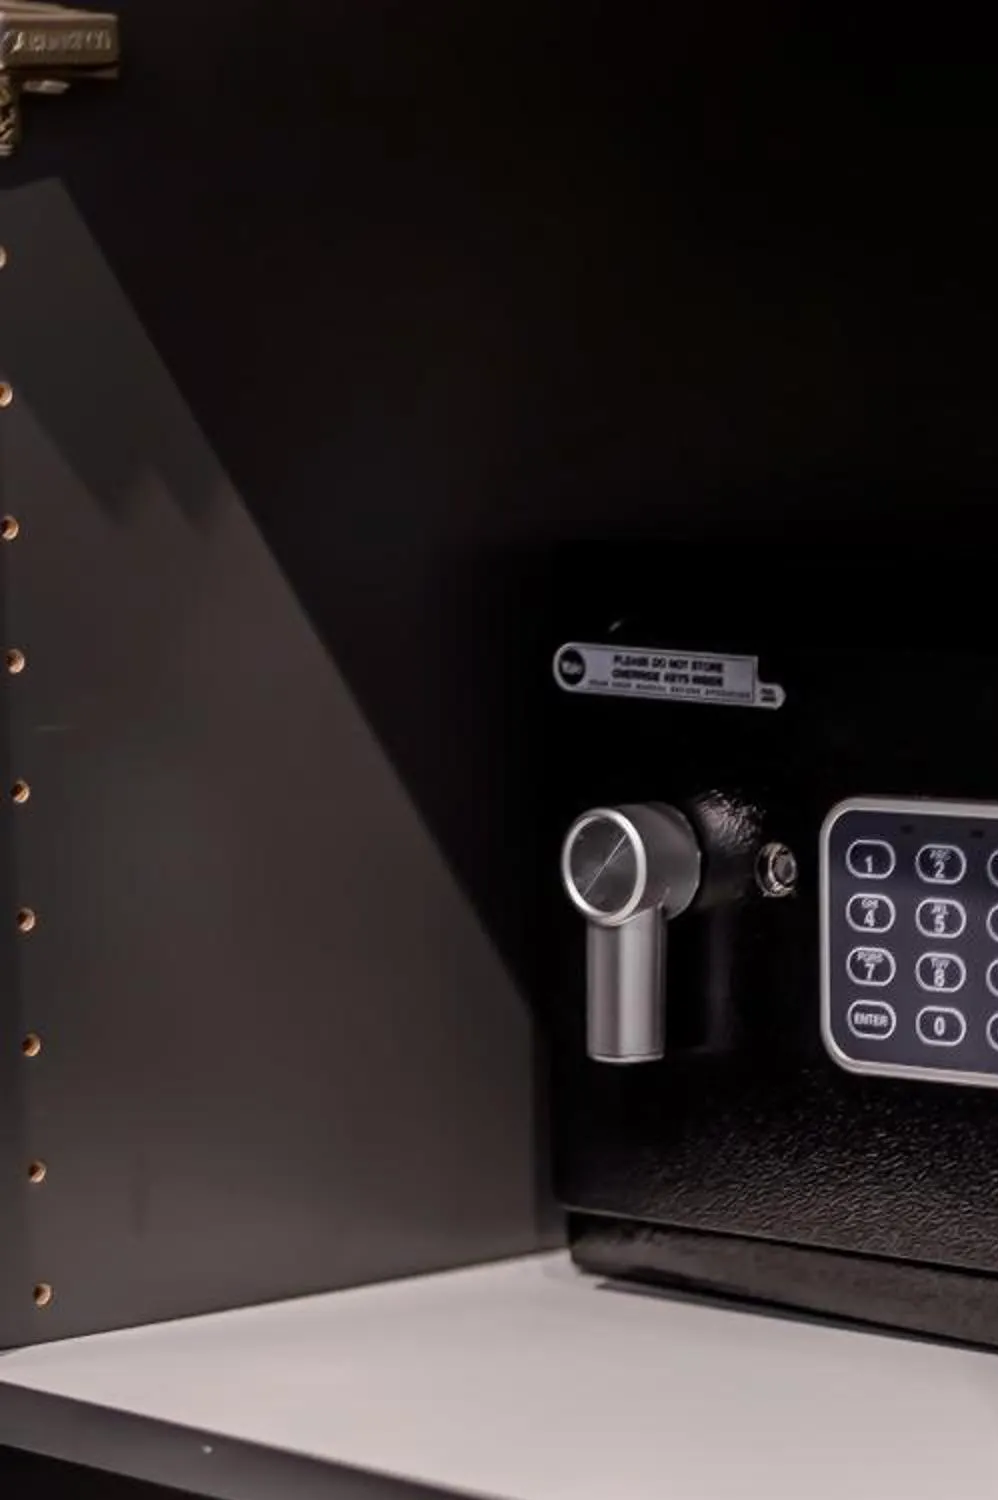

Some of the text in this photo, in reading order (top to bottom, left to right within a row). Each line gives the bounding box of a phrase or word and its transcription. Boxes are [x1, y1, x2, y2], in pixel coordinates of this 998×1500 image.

[864, 855, 873, 873] 1
[934, 861, 945, 879] 2
[864, 910, 875, 927] 4
[934, 915, 945, 933] 5
[864, 963, 875, 980] 7
[934, 969, 945, 987] 8
[854, 1011, 889, 1028] ENTER
[934, 1016, 945, 1036] 0
